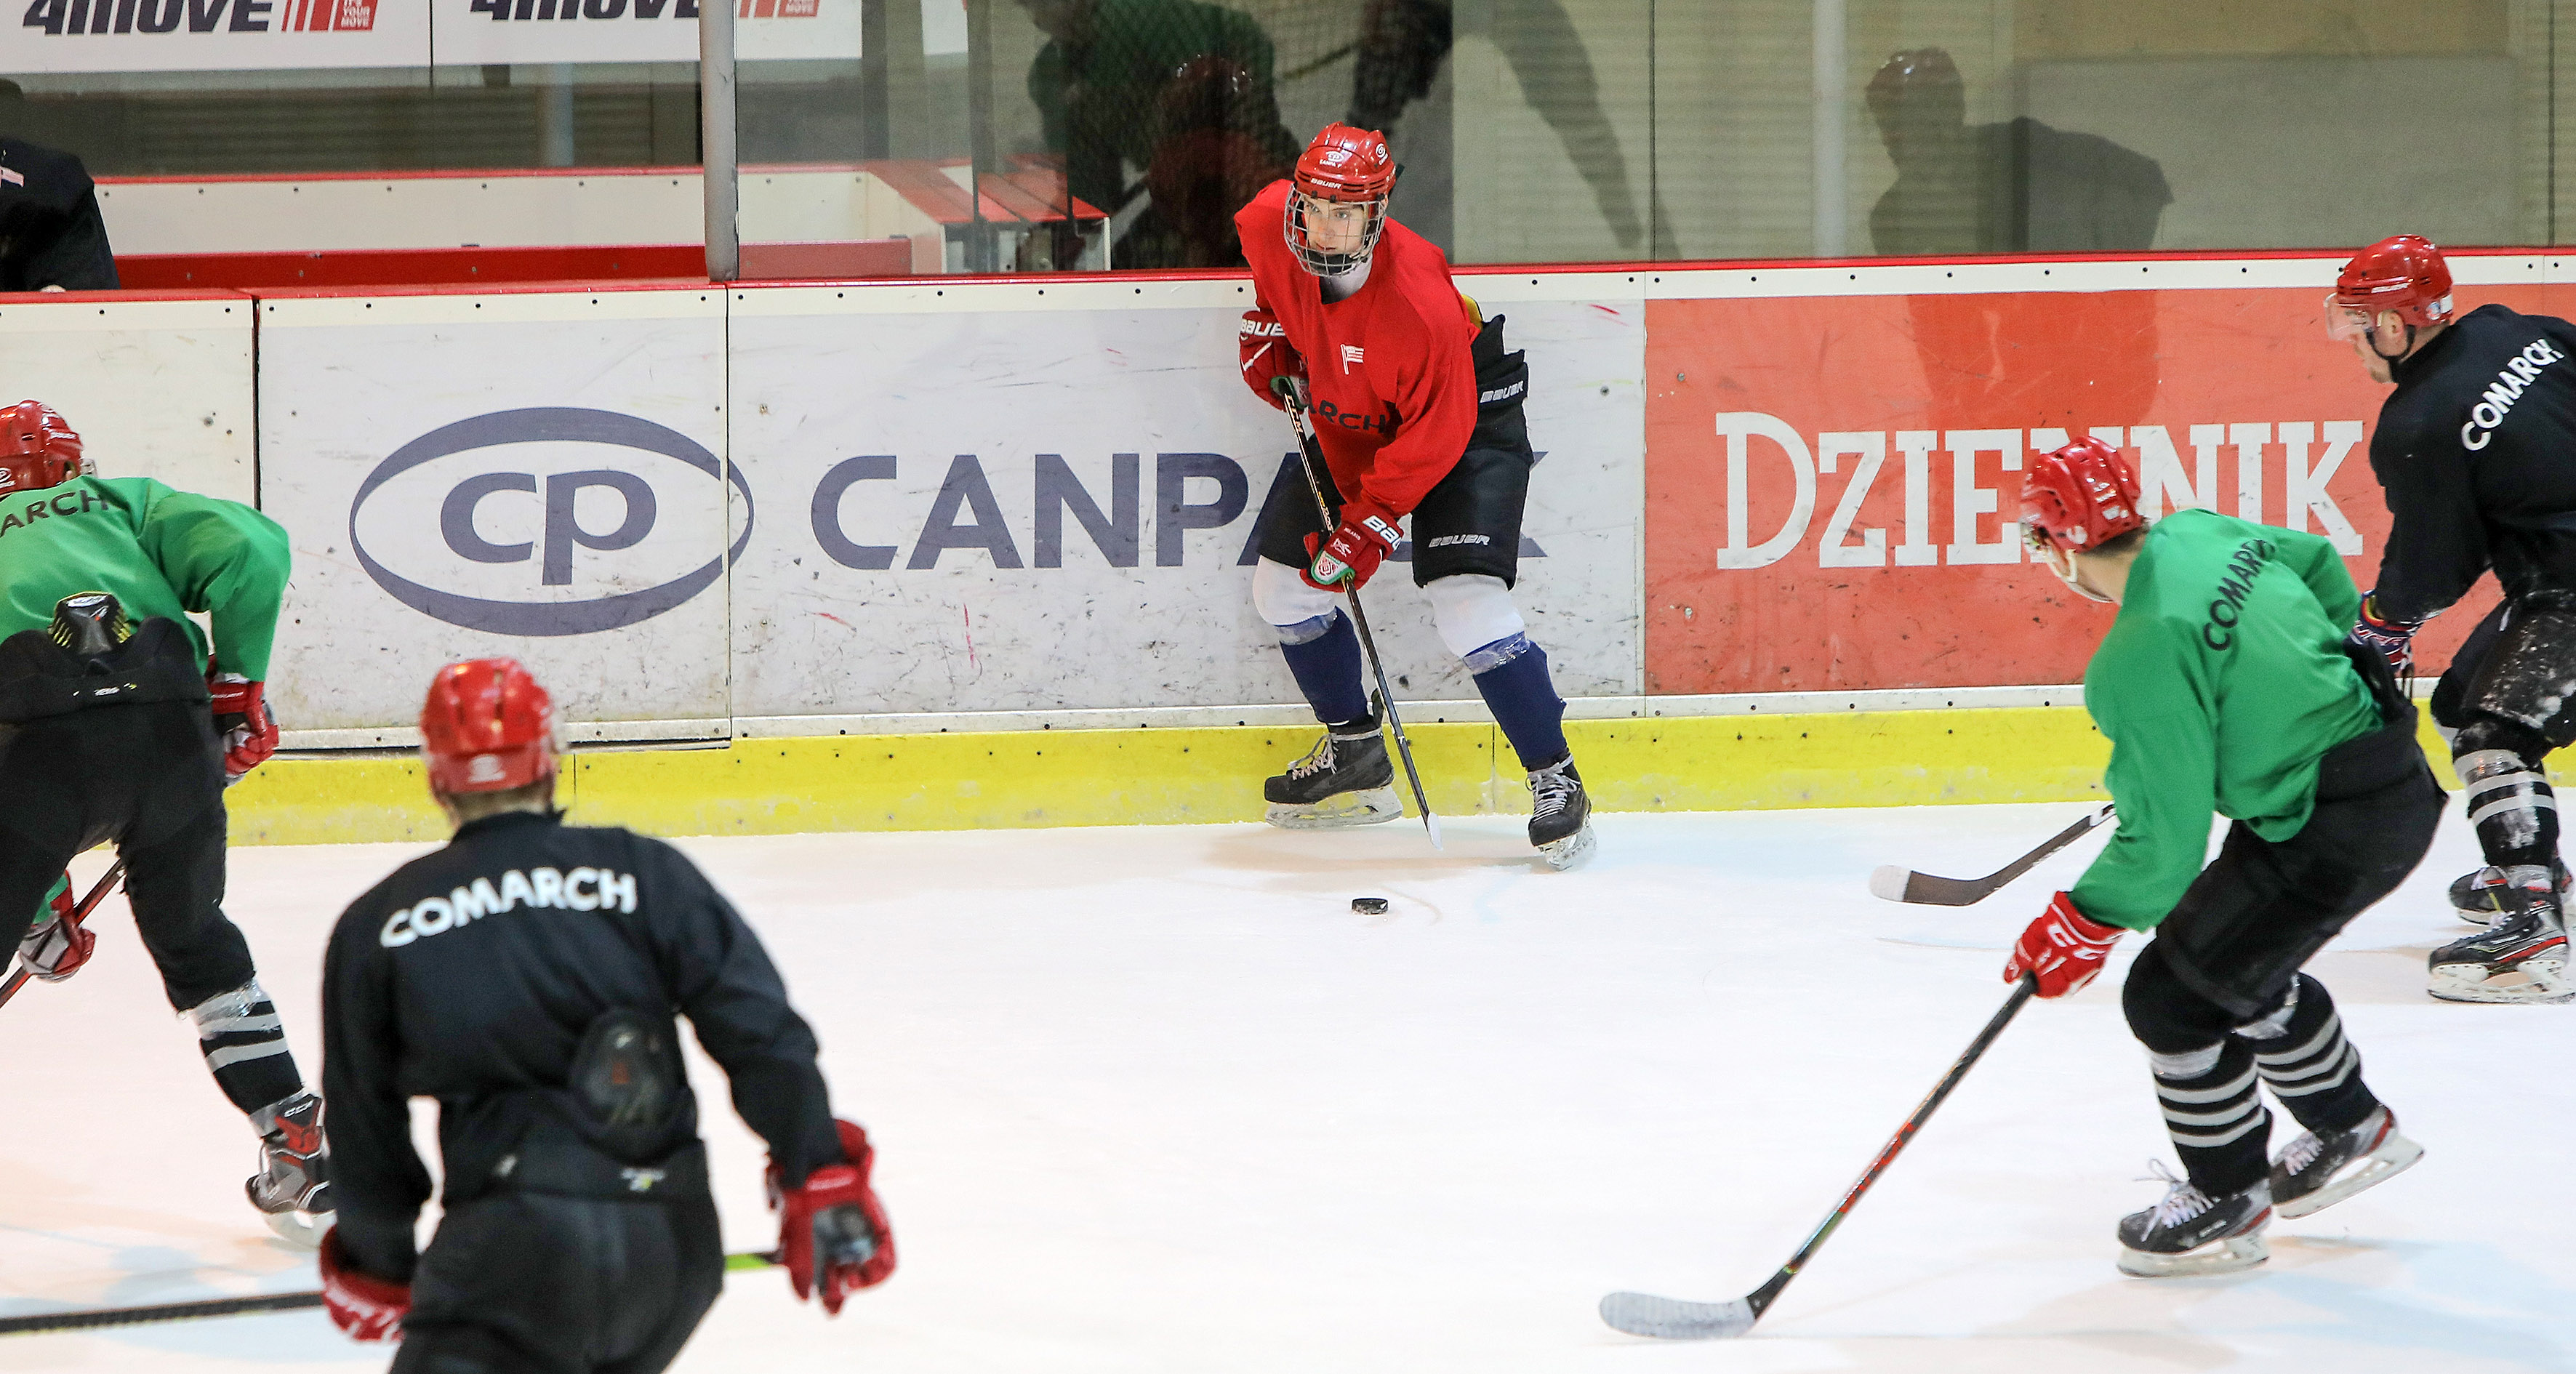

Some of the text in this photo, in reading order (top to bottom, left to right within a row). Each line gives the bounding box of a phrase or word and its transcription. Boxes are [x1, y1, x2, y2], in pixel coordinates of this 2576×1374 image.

[1310, 177, 1341, 189] BAUER
[1240, 318, 1286, 337] BAUE
[1480, 380, 1524, 403] BAUER
[2460, 338, 2565, 451] COMARCH
[0, 489, 109, 538] ARCH
[439, 469, 657, 586] cp
[809, 451, 1549, 571] CANP
[1428, 534, 1490, 548] BAUER
[380, 867, 638, 948] COMARCH
[2047, 922, 2106, 960] CC
